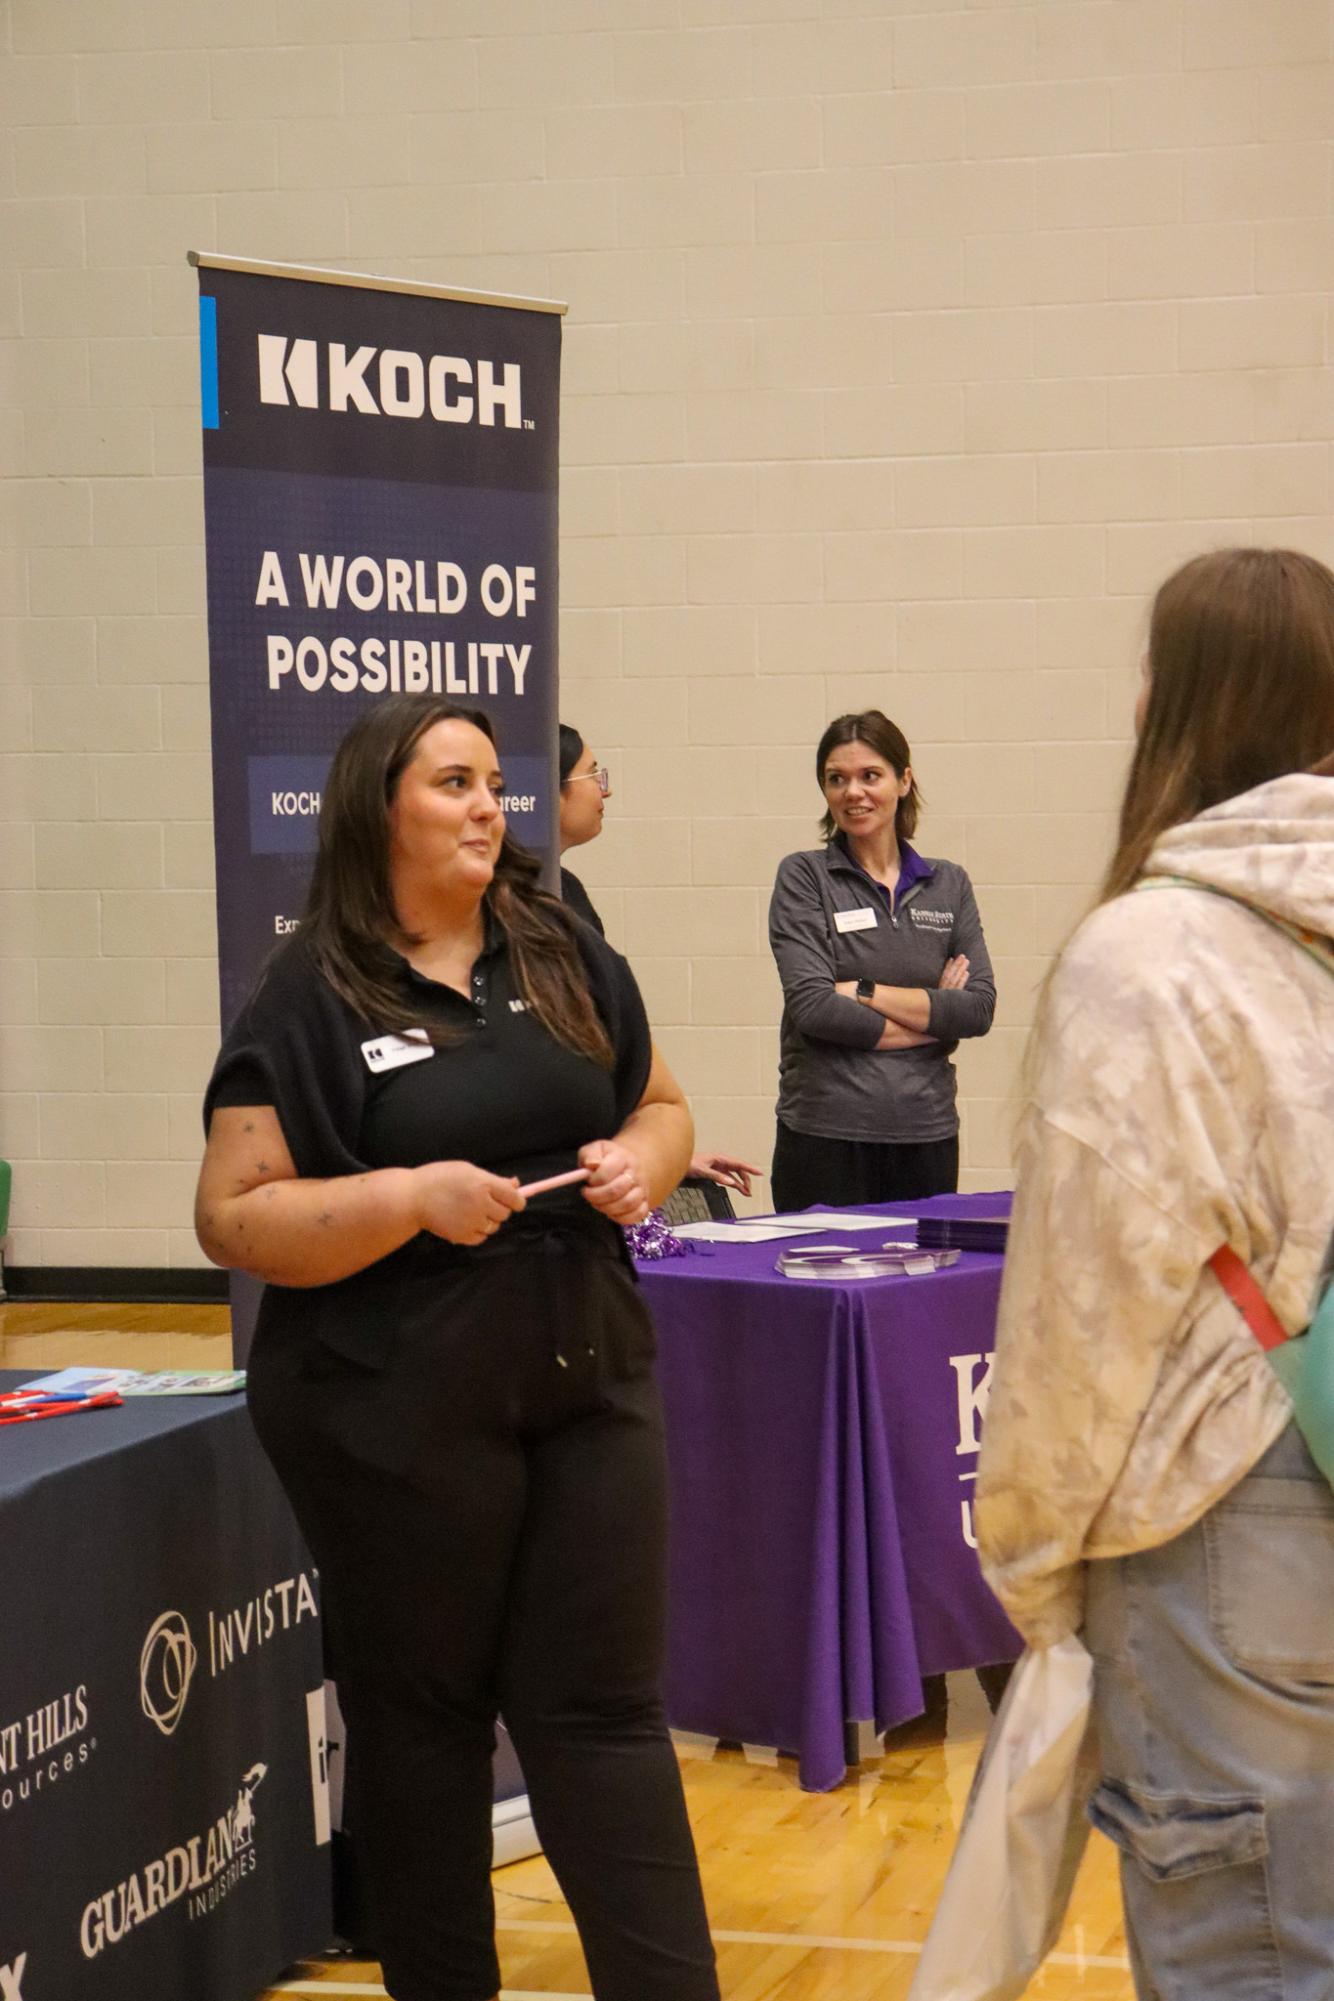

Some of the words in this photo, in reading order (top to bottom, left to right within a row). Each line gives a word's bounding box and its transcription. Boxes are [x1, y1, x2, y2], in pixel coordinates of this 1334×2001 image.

[329, 342, 522, 429] KOCH
[255, 550, 290, 607] A
[299, 553, 468, 614] WORLD
[480, 563, 536, 617] OF
[267, 635, 532, 695] POSSIBILITY
[271, 791, 321, 816] KOCH
[499, 795, 536, 813] reer
[209, 1573, 318, 1678] INVISTA
[26, 1684, 88, 1761] HILLS
[80, 1805, 234, 1958] GUARDIAN
[188, 1848, 256, 1920] INDUSTRIES
